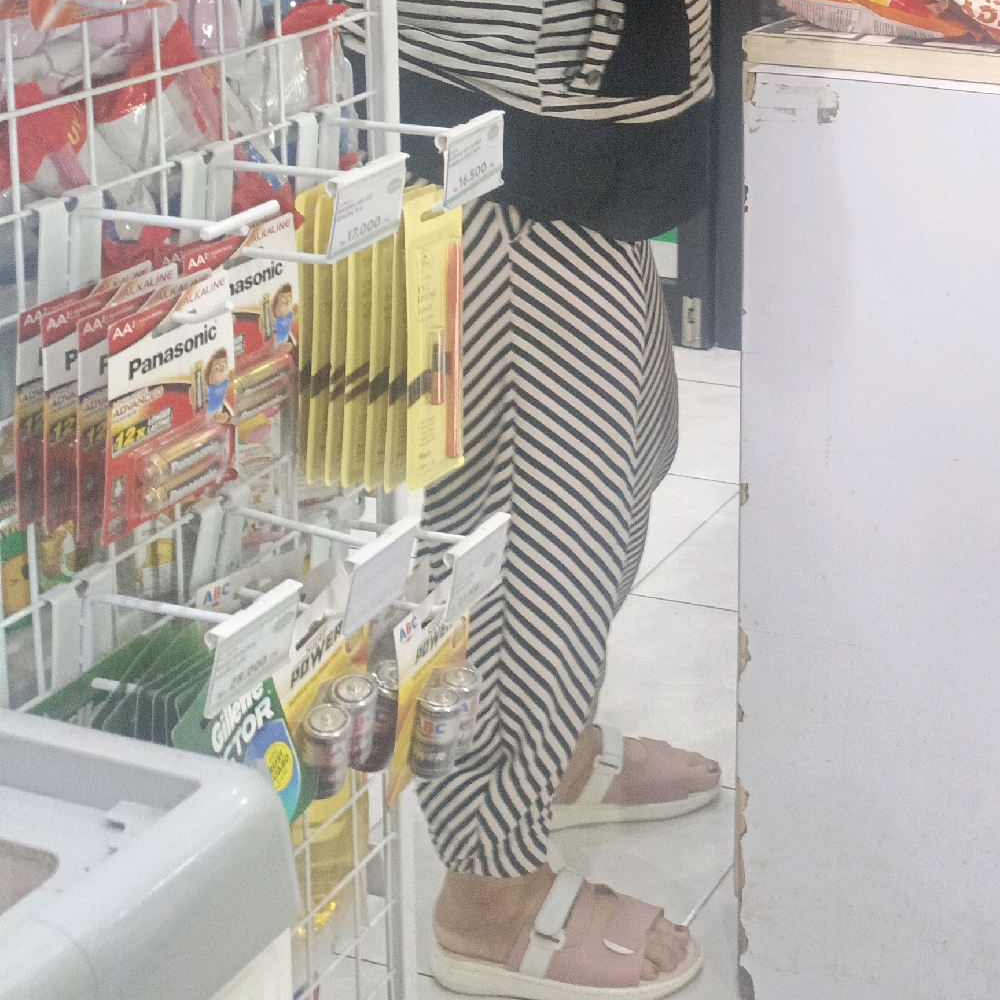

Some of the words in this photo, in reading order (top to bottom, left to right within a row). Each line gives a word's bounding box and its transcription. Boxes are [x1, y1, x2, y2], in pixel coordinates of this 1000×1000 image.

[347, 216, 381, 241] 17.000
[128, 324, 217, 380] Panasonic
[114, 387, 164, 417] ADVANCED
[116, 426, 147, 450] 12x
[203, 582, 230, 605] ABC
[400, 616, 417, 643] ABC
[290, 619, 343, 689] POWER
